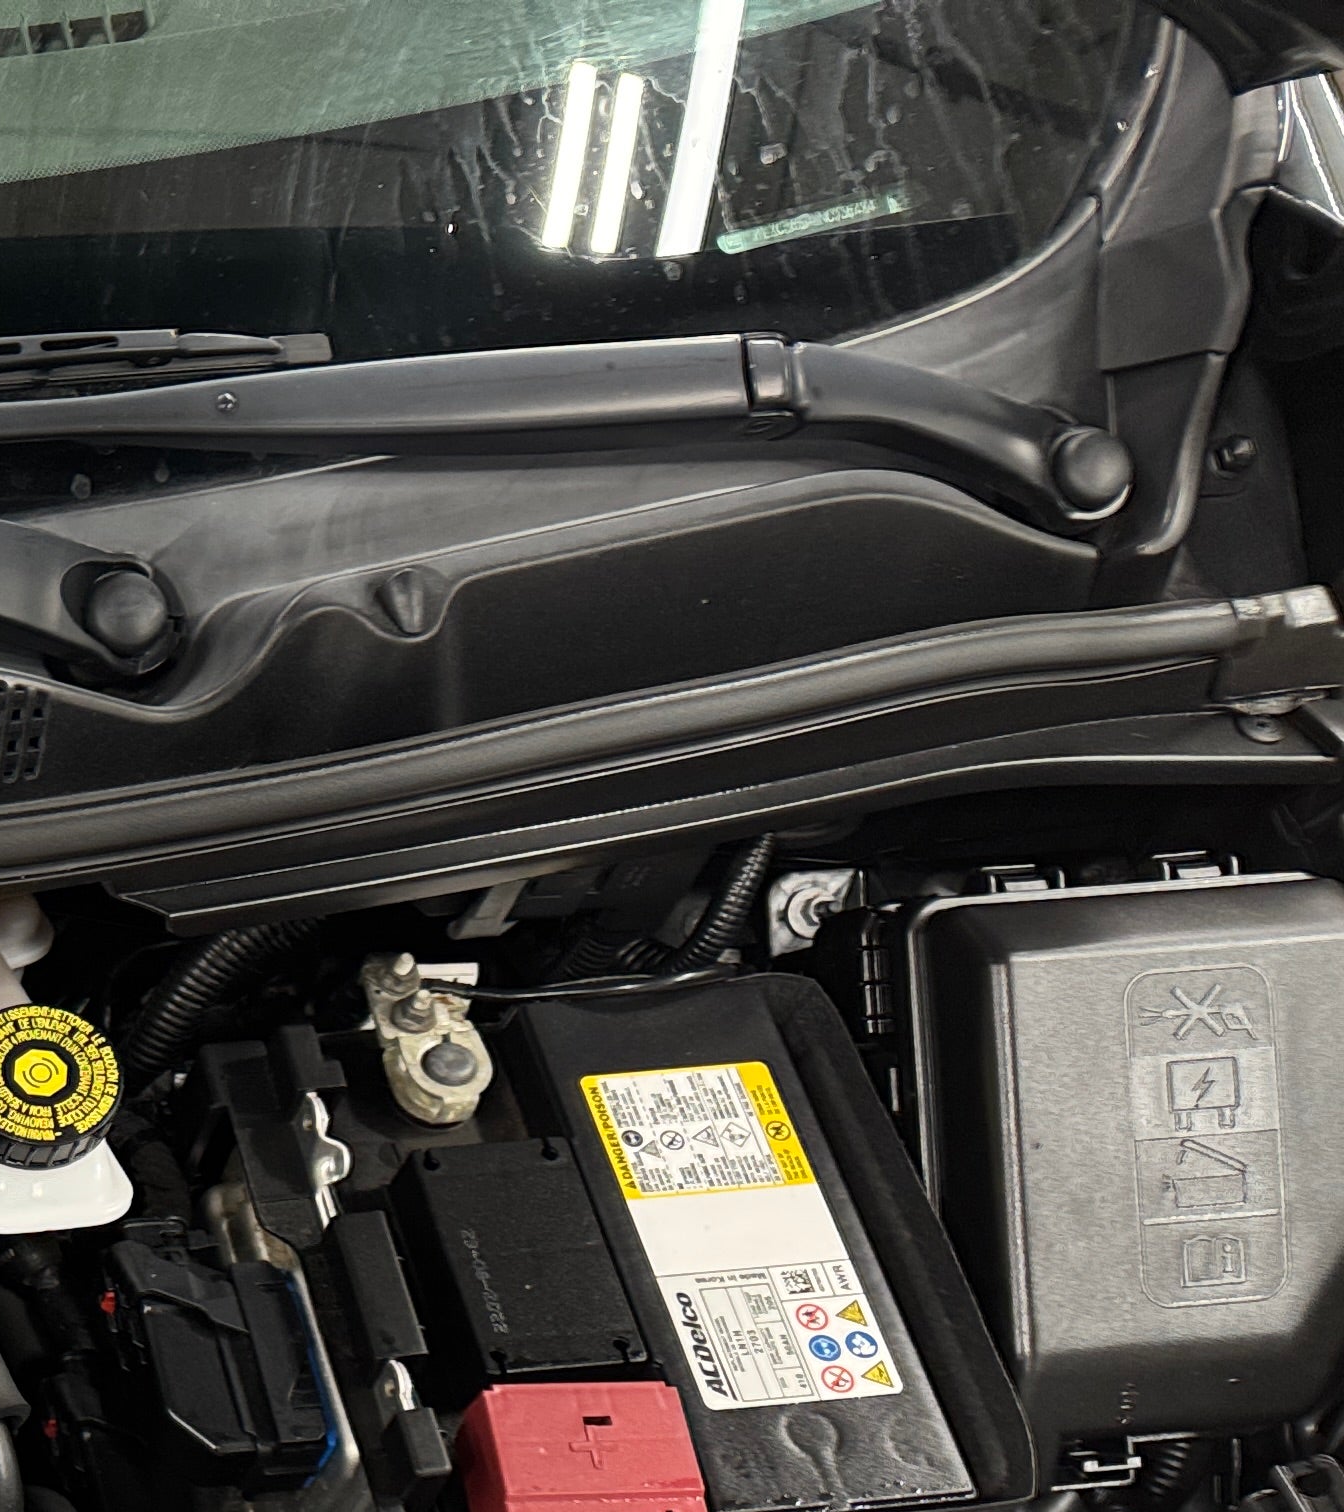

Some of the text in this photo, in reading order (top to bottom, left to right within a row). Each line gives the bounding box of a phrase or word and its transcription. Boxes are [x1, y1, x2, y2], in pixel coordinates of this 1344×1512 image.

[587, 1085, 635, 1182] DANGER/POISON
[830, 1263, 854, 1292] AWR
[675, 1292, 729, 1398] ACDelco
